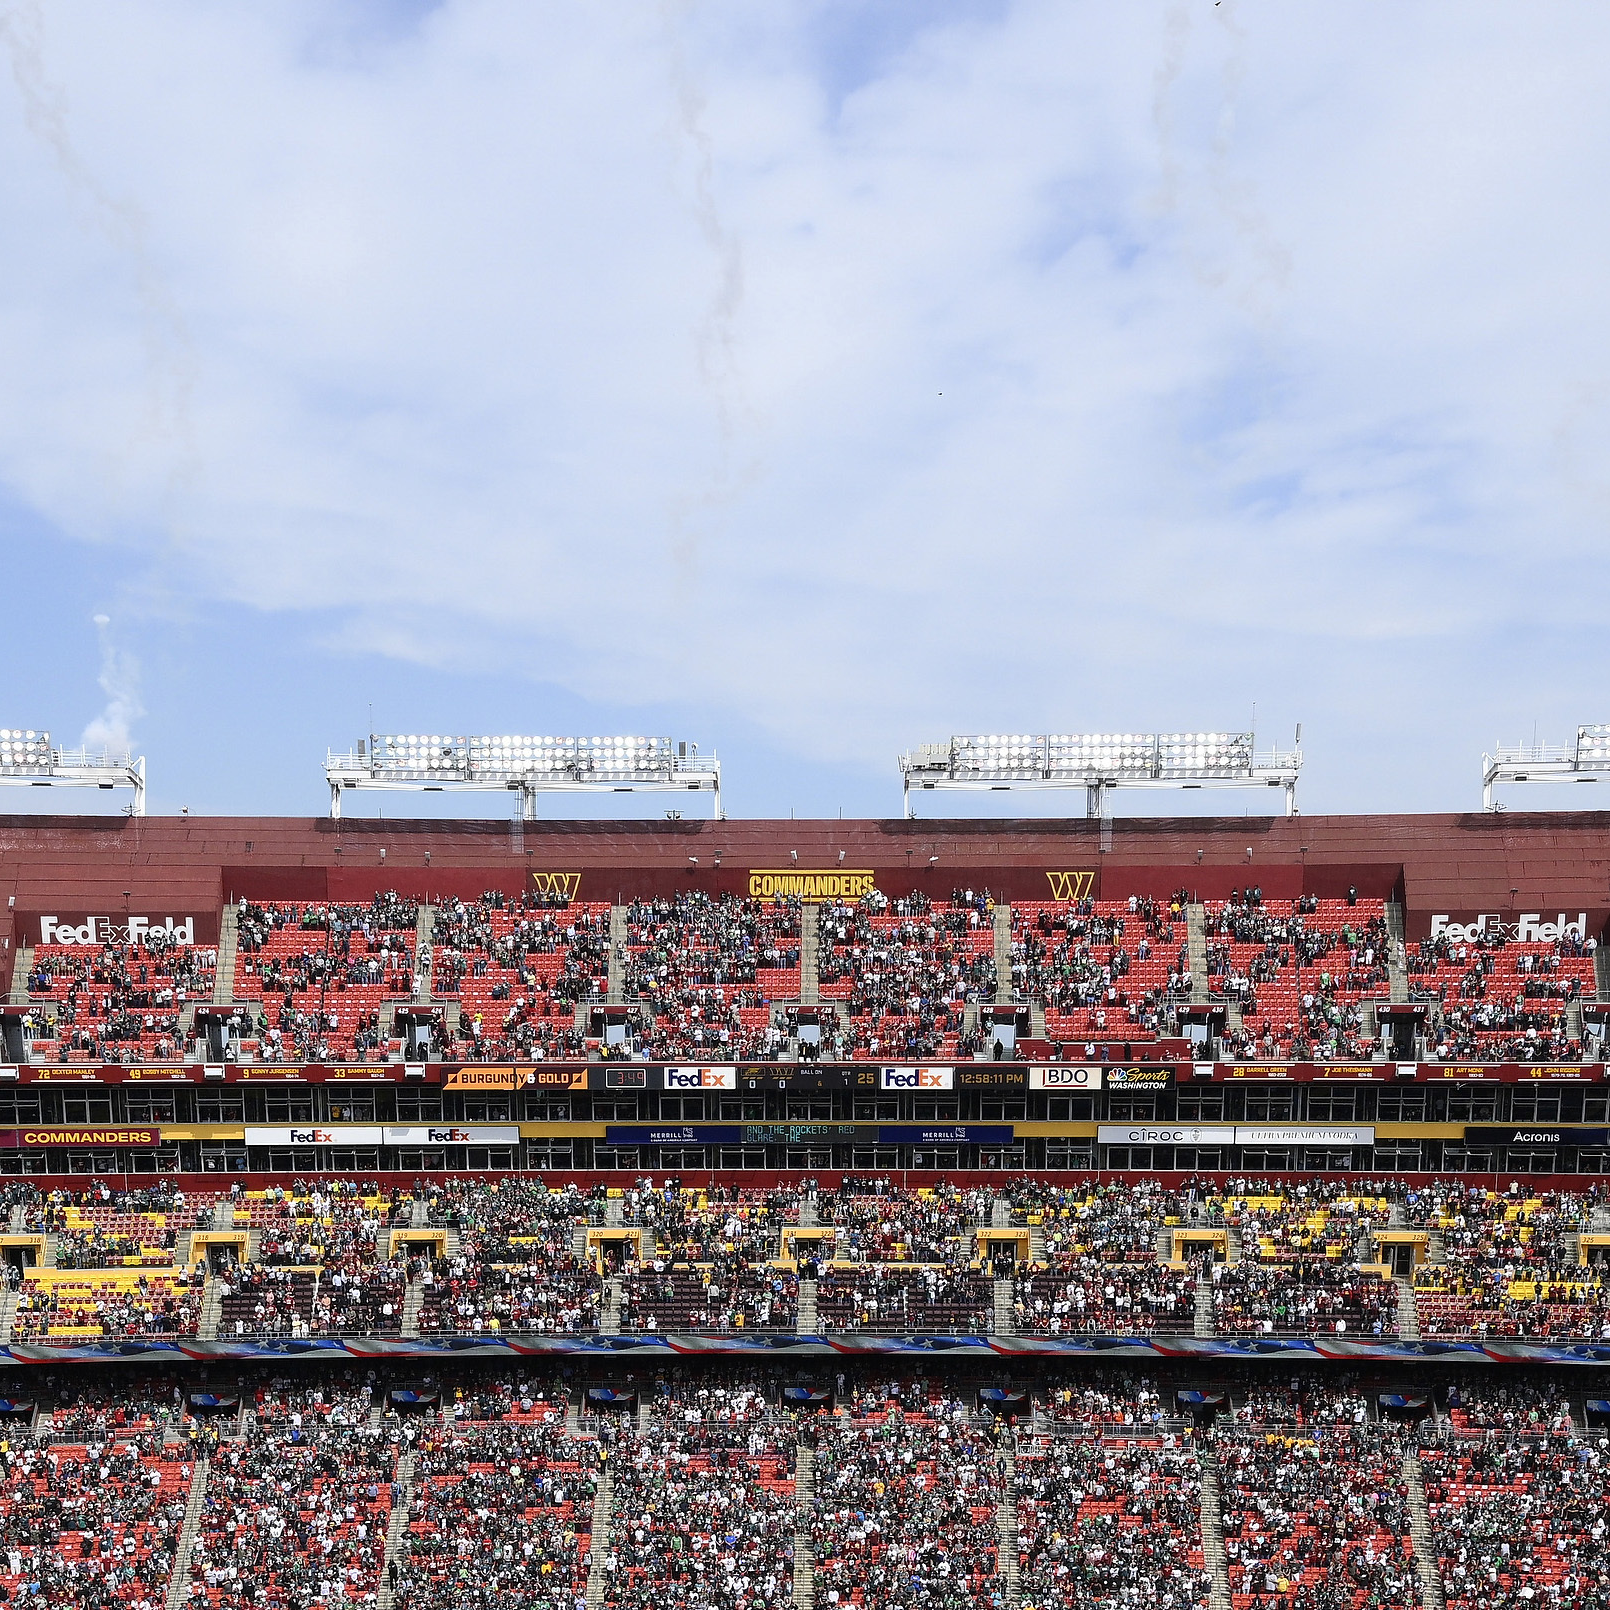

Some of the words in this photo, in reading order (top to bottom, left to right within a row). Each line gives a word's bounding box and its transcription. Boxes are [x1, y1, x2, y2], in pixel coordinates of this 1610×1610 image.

[749, 876, 874, 896] COMMANDERS
[40, 915, 194, 944] FedExField
[1431, 913, 1587, 943] FedExField
[461, 1072, 526, 1085] BURGUNDY
[526, 1072, 535, 1084] &
[538, 1072, 569, 1084] GOLD
[617, 1071, 645, 1084] 3:49
[668, 1069, 725, 1088] FedEx
[857, 1072, 875, 1084] 25
[885, 1069, 942, 1087] FedEx
[959, 1072, 1004, 1085] 12:58:11
[1006, 1072, 1024, 1084] PM
[1049, 1069, 1088, 1084] BDO
[1127, 1067, 1170, 1083] Sports
[1108, 1081, 1168, 1090] WASHINGTON
[746, 1125, 764, 1134] AND
[767, 1125, 785, 1134] THE
[839, 1125, 855, 1134] RED
[24, 1131, 152, 1144] COMMANDERS
[290, 1130, 332, 1143] FedEx
[428, 1130, 470, 1143] FedEx
[785, 1133, 801, 1142] THE
[1513, 1131, 1560, 1142] Acronis
